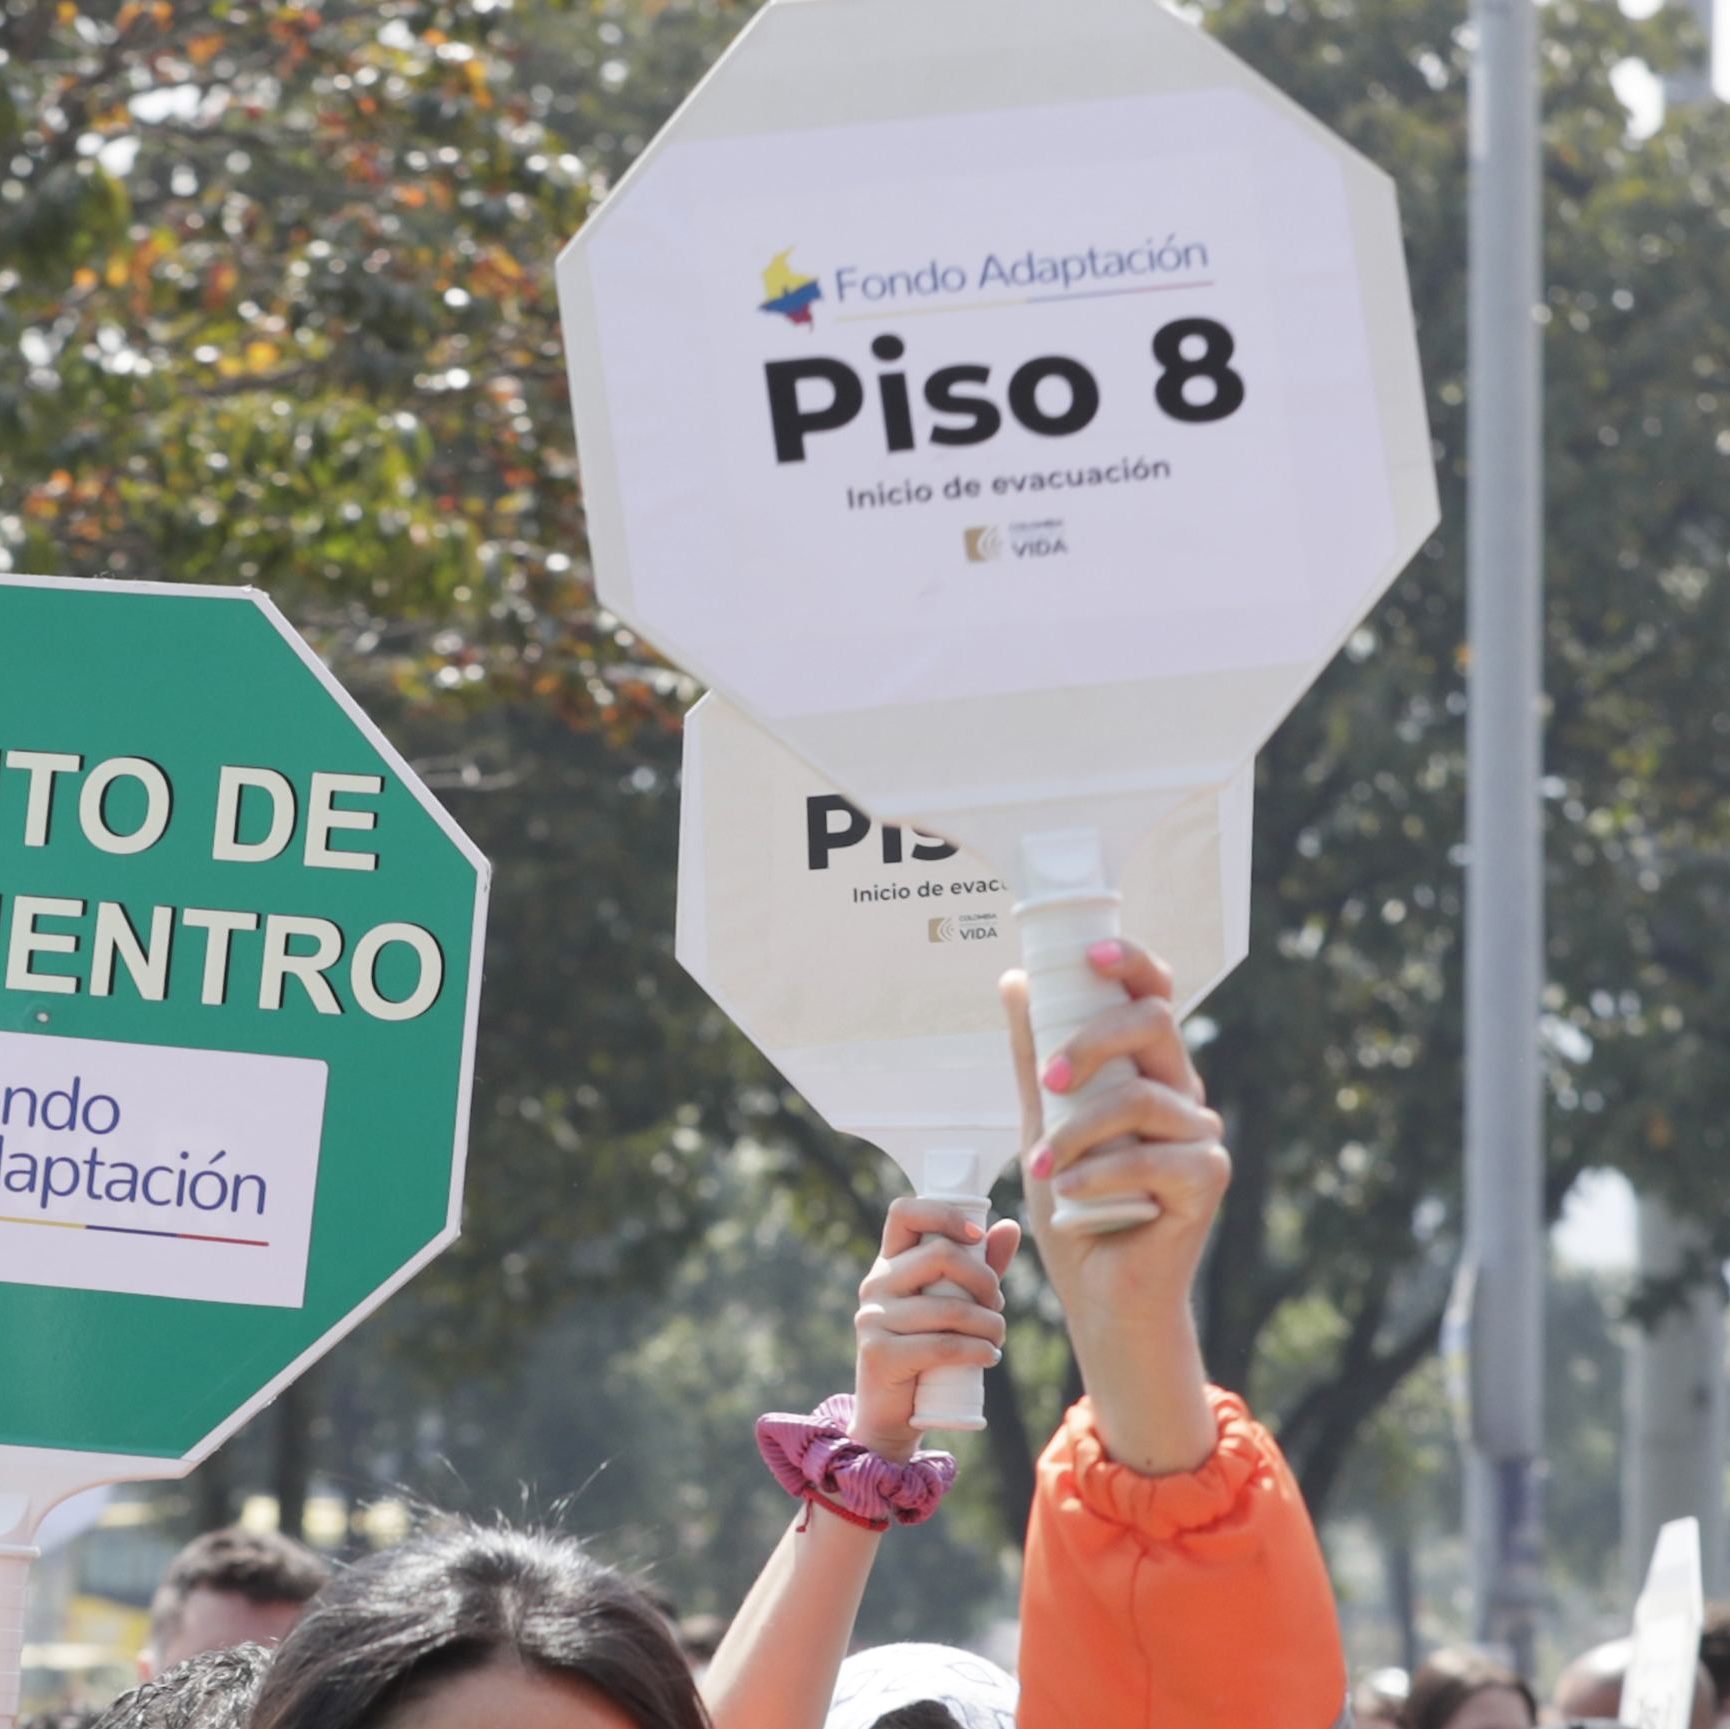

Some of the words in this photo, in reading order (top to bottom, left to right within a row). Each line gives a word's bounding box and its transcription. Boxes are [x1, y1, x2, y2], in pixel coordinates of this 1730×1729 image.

[833, 259, 969, 304] Fondo
[976, 233, 1209, 290] Adaptación
[763, 334, 1102, 464] Piso
[1152, 317, 1246, 424] 8
[846, 480, 933, 509] Inicio
[942, 475, 981, 500] de
[990, 456, 1170, 496] evacuación
[1011, 537, 1069, 559] VIDA
[212, 765, 385, 872] DE
[852, 882, 911, 904] Inicio
[917, 880, 944, 898] de
[959, 926, 998, 940] VIDA
